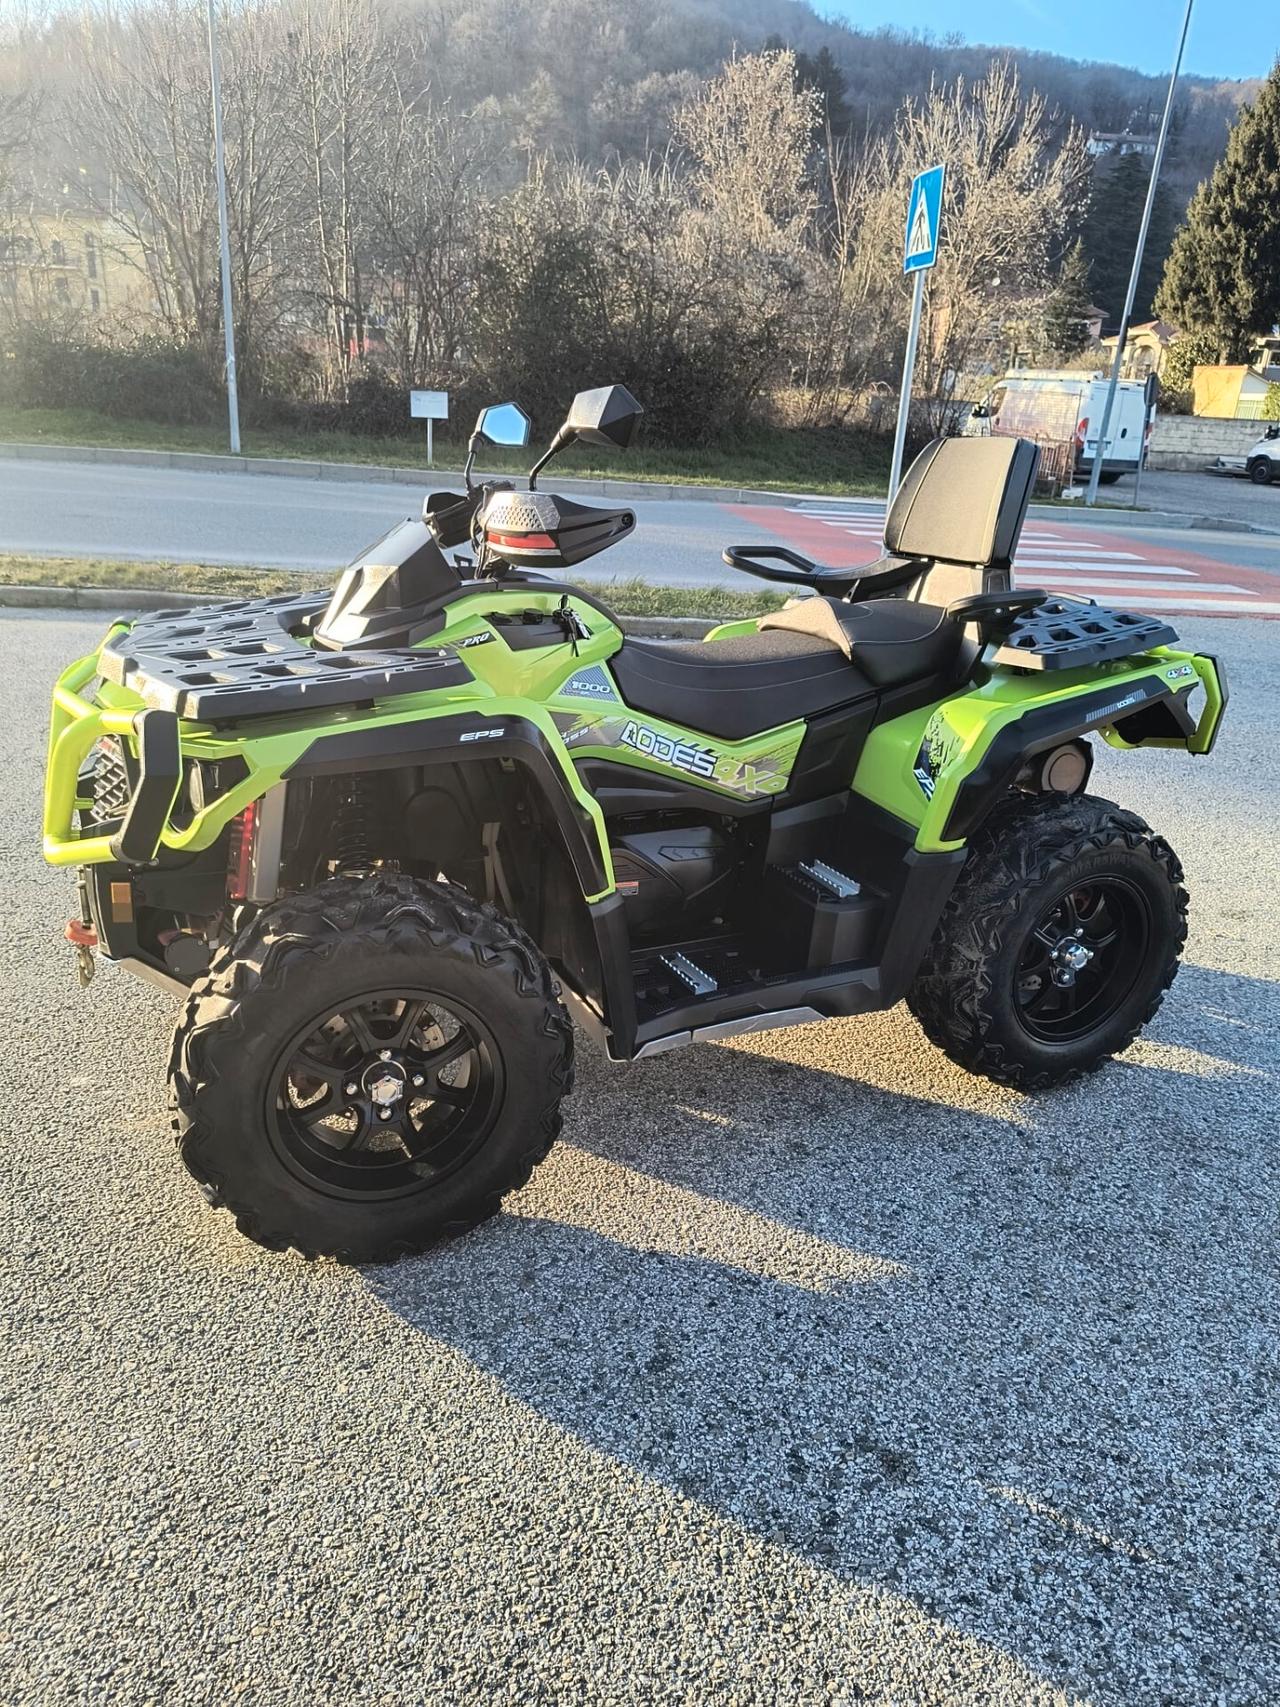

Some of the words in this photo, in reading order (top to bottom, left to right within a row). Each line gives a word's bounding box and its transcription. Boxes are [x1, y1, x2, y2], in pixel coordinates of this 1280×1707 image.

[463, 632, 490, 648] PRO
[571, 680, 611, 694] 1000
[460, 728, 505, 741] EPS
[620, 720, 718, 778] AODES
